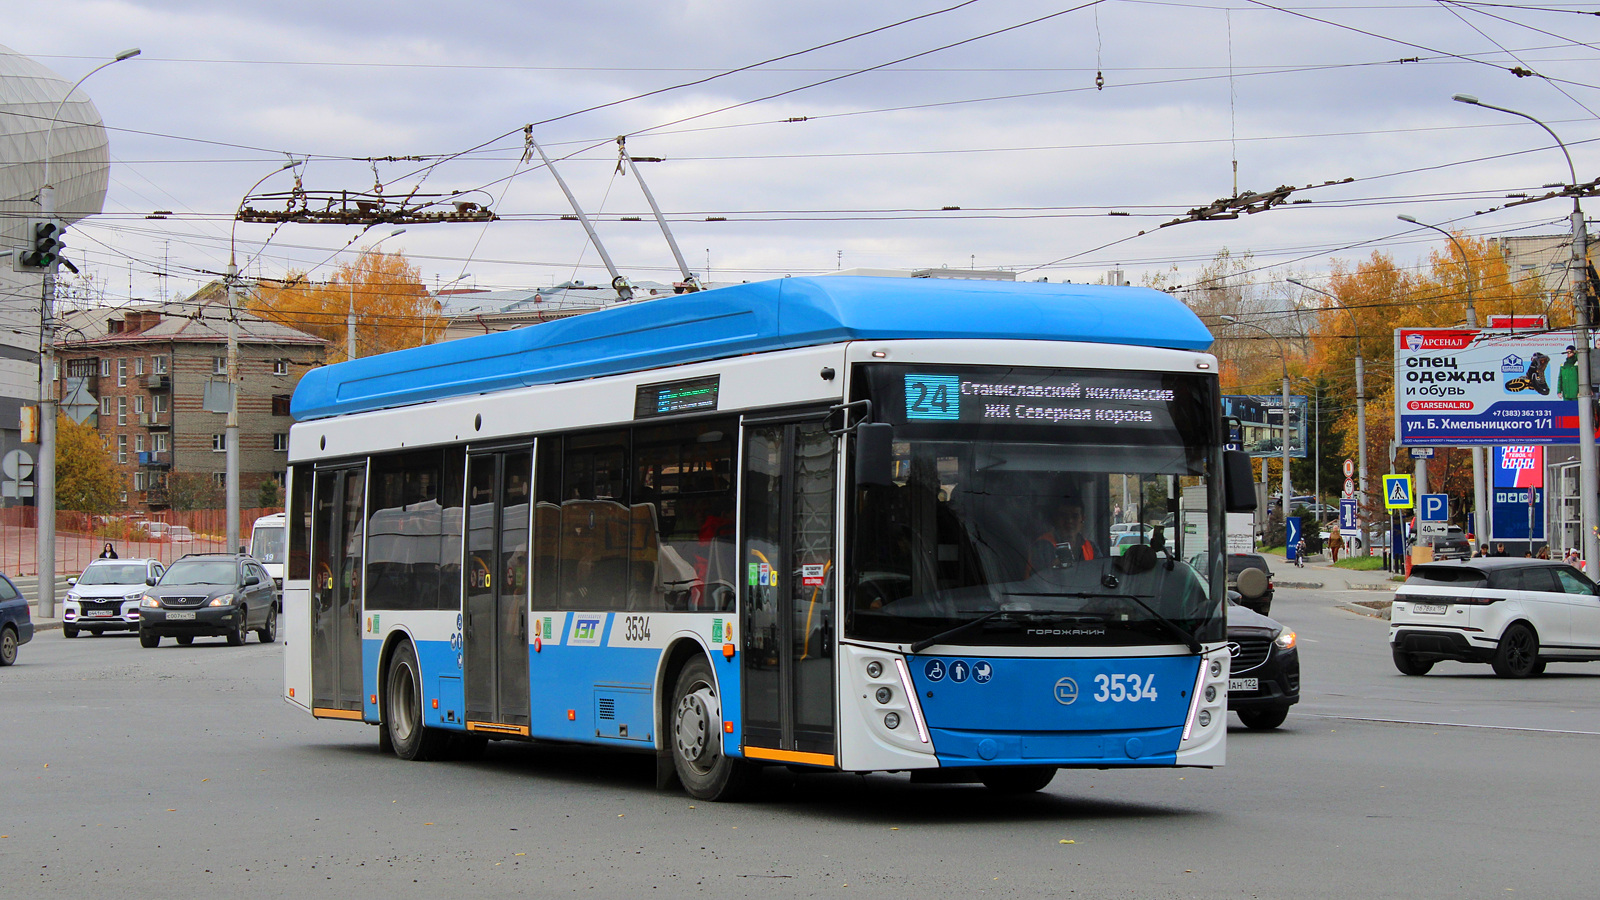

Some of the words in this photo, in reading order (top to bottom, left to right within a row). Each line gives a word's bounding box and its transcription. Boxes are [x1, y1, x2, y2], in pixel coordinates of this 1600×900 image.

[1406, 357, 1458, 370] спец
[1406, 371, 1495, 384] одежда
[911, 382, 950, 413] 24
[960, 381, 1080, 398] Станиславский
[1085, 387, 1174, 401] жилмассив
[1406, 387, 1416, 395] и
[1419, 384, 1465, 397] обувь
[984, 404, 1010, 418] ЖК
[1015, 405, 1091, 423] Северная
[1095, 409, 1152, 424] корона
[1406, 421, 1425, 432] ул.
[1427, 418, 1439, 429] Б.
[1441, 418, 1533, 431] Хмельницкого
[1534, 418, 1552, 429] 1/1
[1427, 497, 1442, 519] P
[265, 553, 274, 561] 19
[625, 616, 650, 641] 3534
[1094, 674, 1158, 702] 3534
